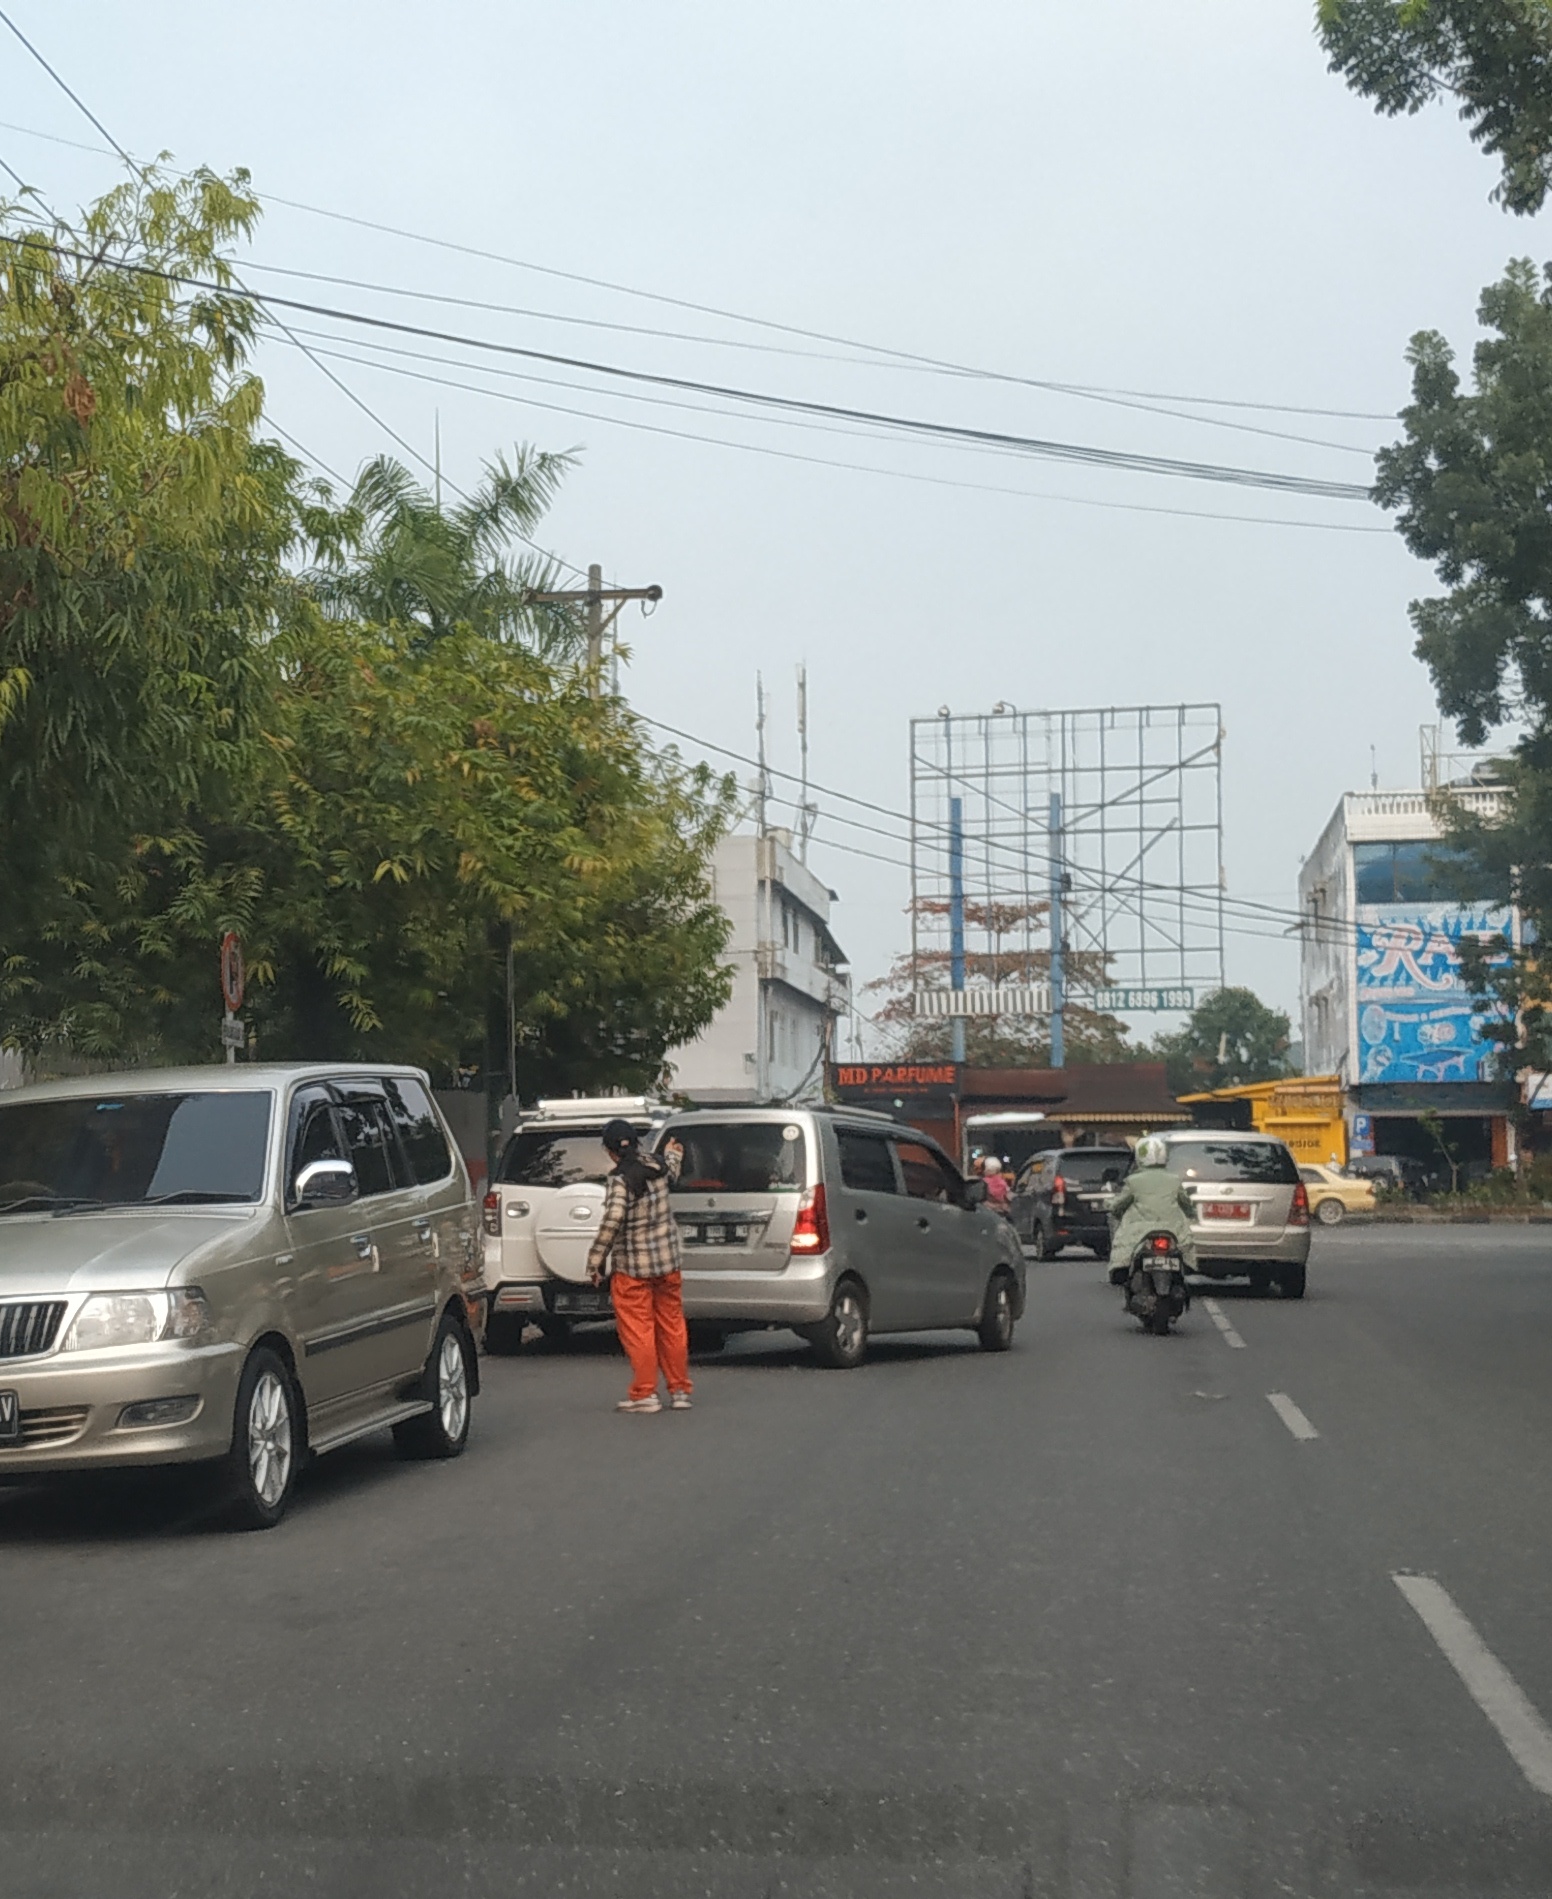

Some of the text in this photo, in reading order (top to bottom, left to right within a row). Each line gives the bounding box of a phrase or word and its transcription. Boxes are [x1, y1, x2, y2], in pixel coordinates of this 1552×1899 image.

[1096, 991, 1126, 1009] 0812
[838, 1065, 956, 1086] MD PARFUME
